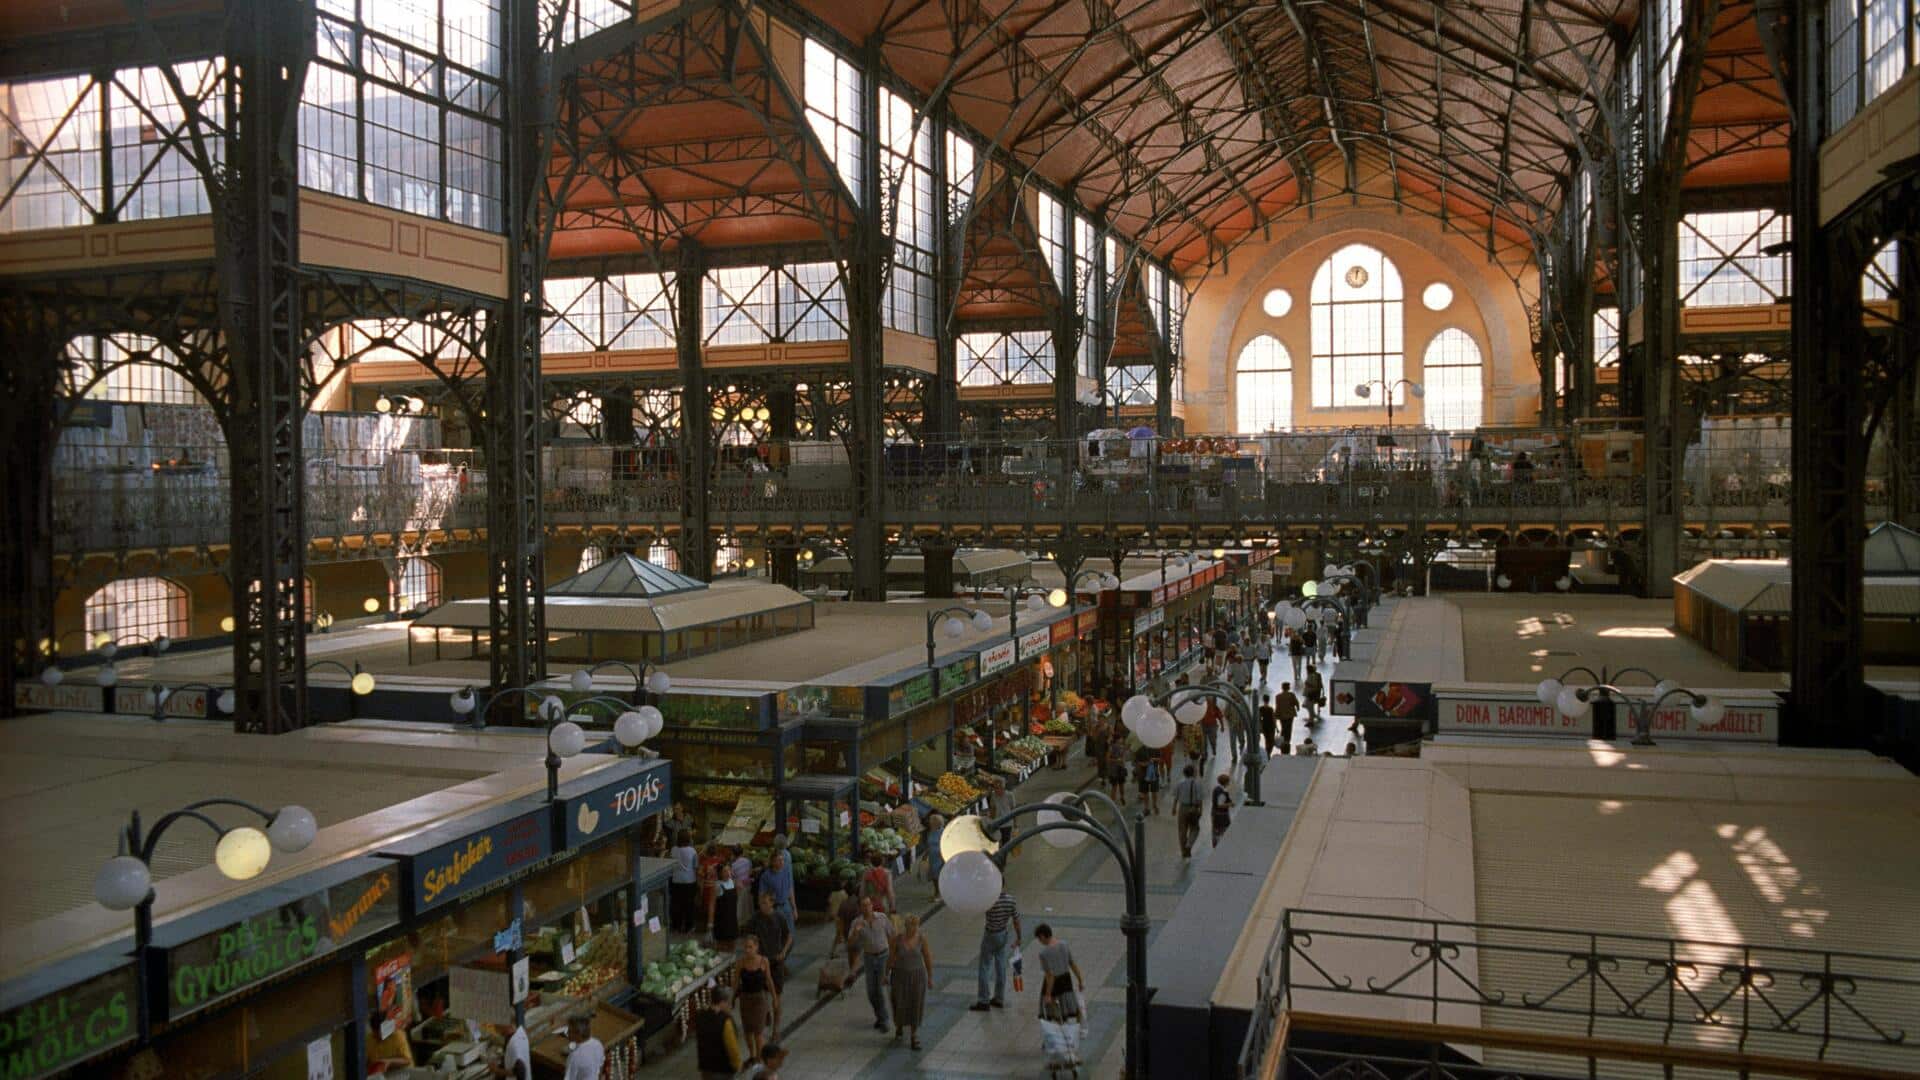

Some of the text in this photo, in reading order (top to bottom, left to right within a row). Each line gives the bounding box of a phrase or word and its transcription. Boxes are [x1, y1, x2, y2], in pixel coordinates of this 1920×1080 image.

[1498, 704, 1555, 728] BAROMFI
[1628, 708, 1687, 732] BOMFI
[615, 773, 660, 816] TOJÁS
[175, 913, 318, 1006] GYÜMÖLCS
